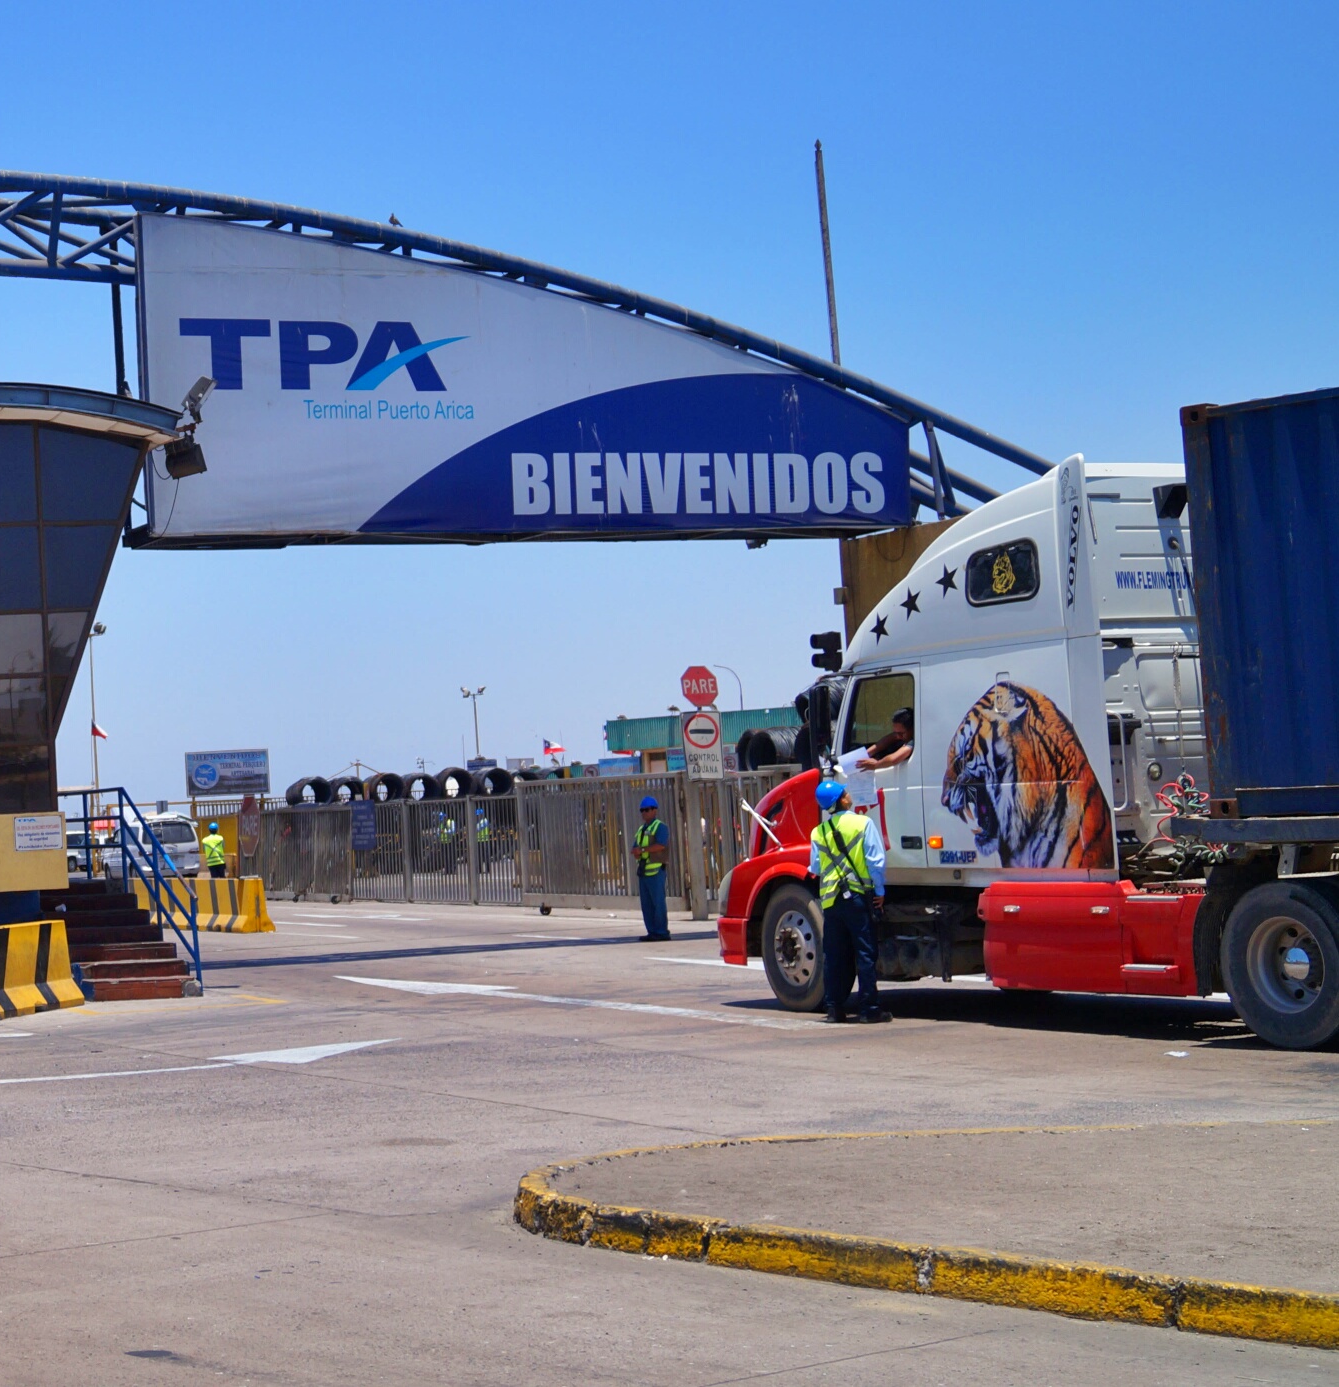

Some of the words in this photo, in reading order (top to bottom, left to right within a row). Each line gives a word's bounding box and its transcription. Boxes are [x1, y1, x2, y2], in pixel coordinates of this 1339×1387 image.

[179, 318, 471, 391] TPA
[303, 399, 373, 419] Terminal
[377, 400, 431, 419] Puerto
[434, 400, 475, 419] Arica
[511, 451, 885, 515] BIENVENIDOS
[1066, 505, 1079, 610] VOLVO
[683, 678, 716, 694] PARE
[688, 753, 719, 762] CONTROL
[692, 765, 718, 773] ADUANA
